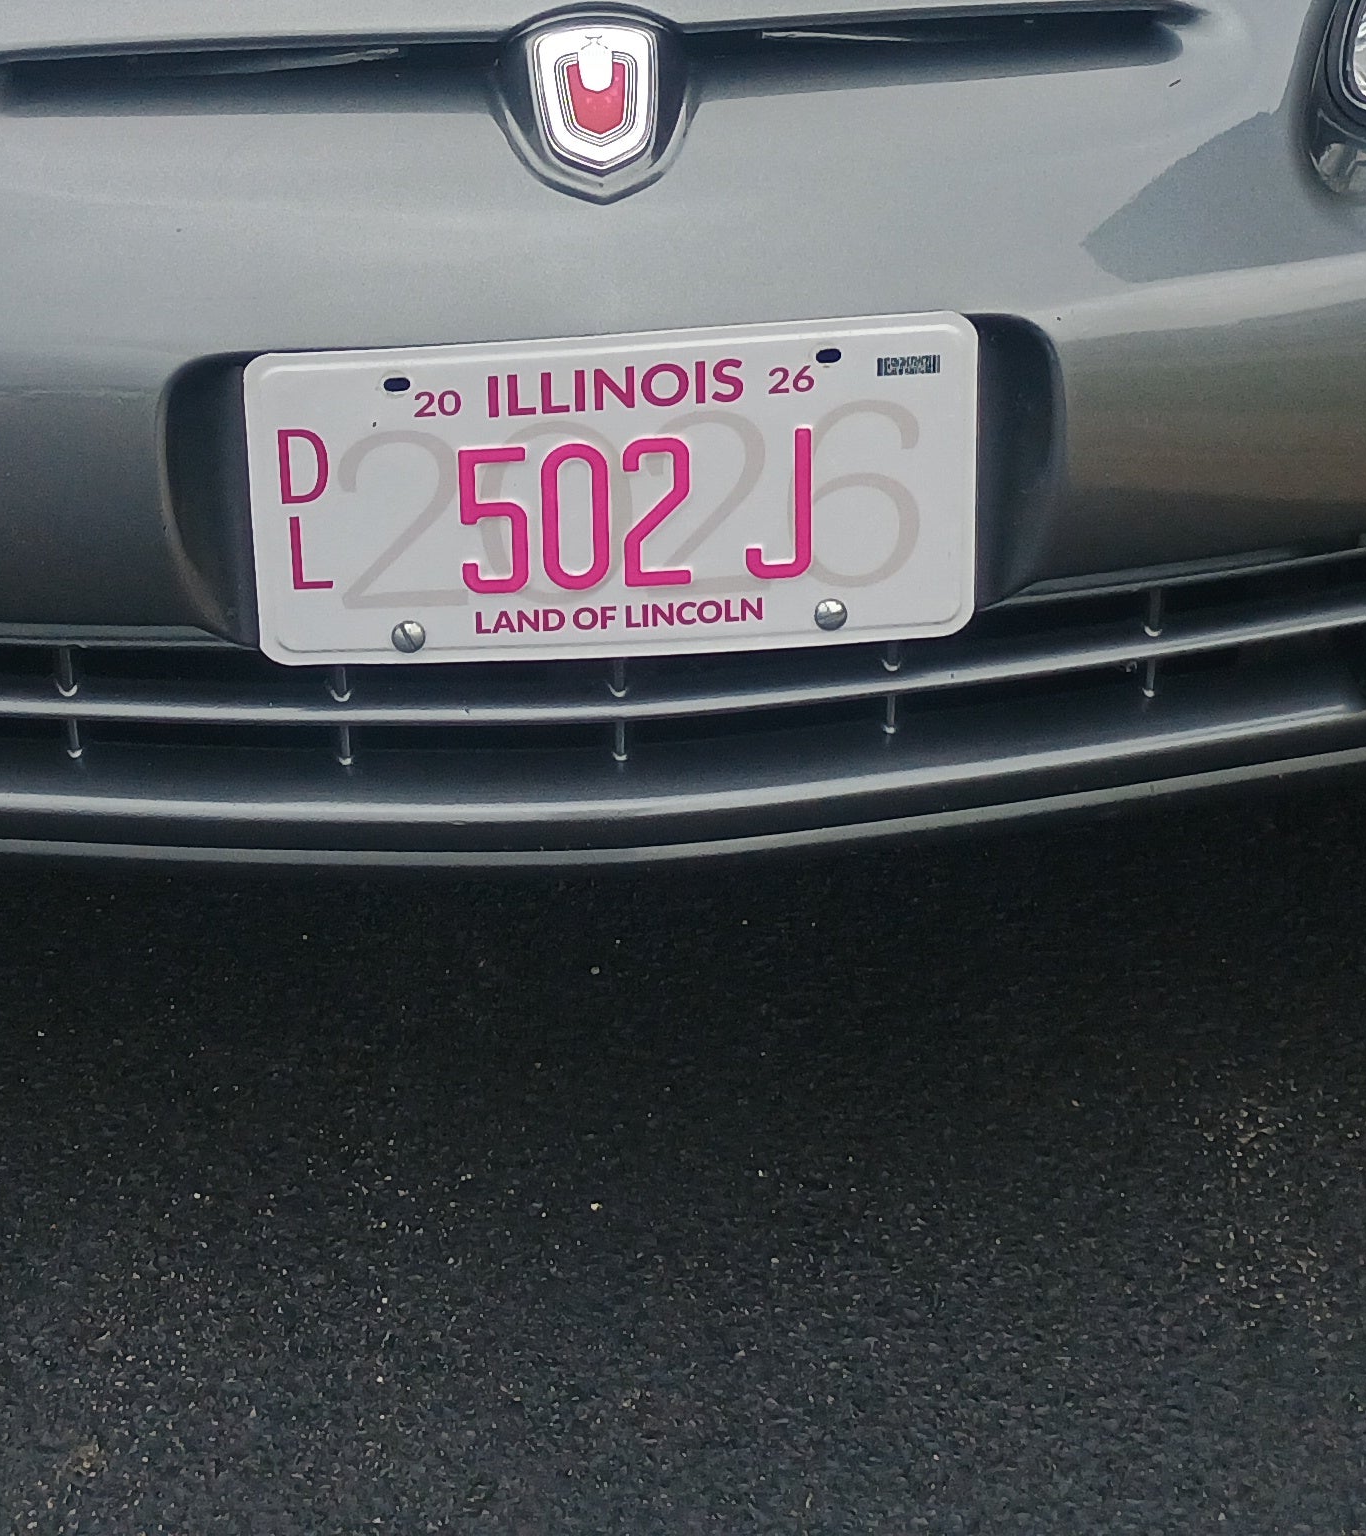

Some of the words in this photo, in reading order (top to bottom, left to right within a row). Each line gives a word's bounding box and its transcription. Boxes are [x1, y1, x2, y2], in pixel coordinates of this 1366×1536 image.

[413, 390, 462, 418] 20
[487, 358, 745, 419] ILLINOIS
[768, 366, 816, 395] 26
[457, 437, 692, 594] 502
[745, 427, 813, 579] J
[474, 608, 567, 635] LAND
[572, 605, 618, 631] OF
[625, 596, 765, 629] LINCOLN
